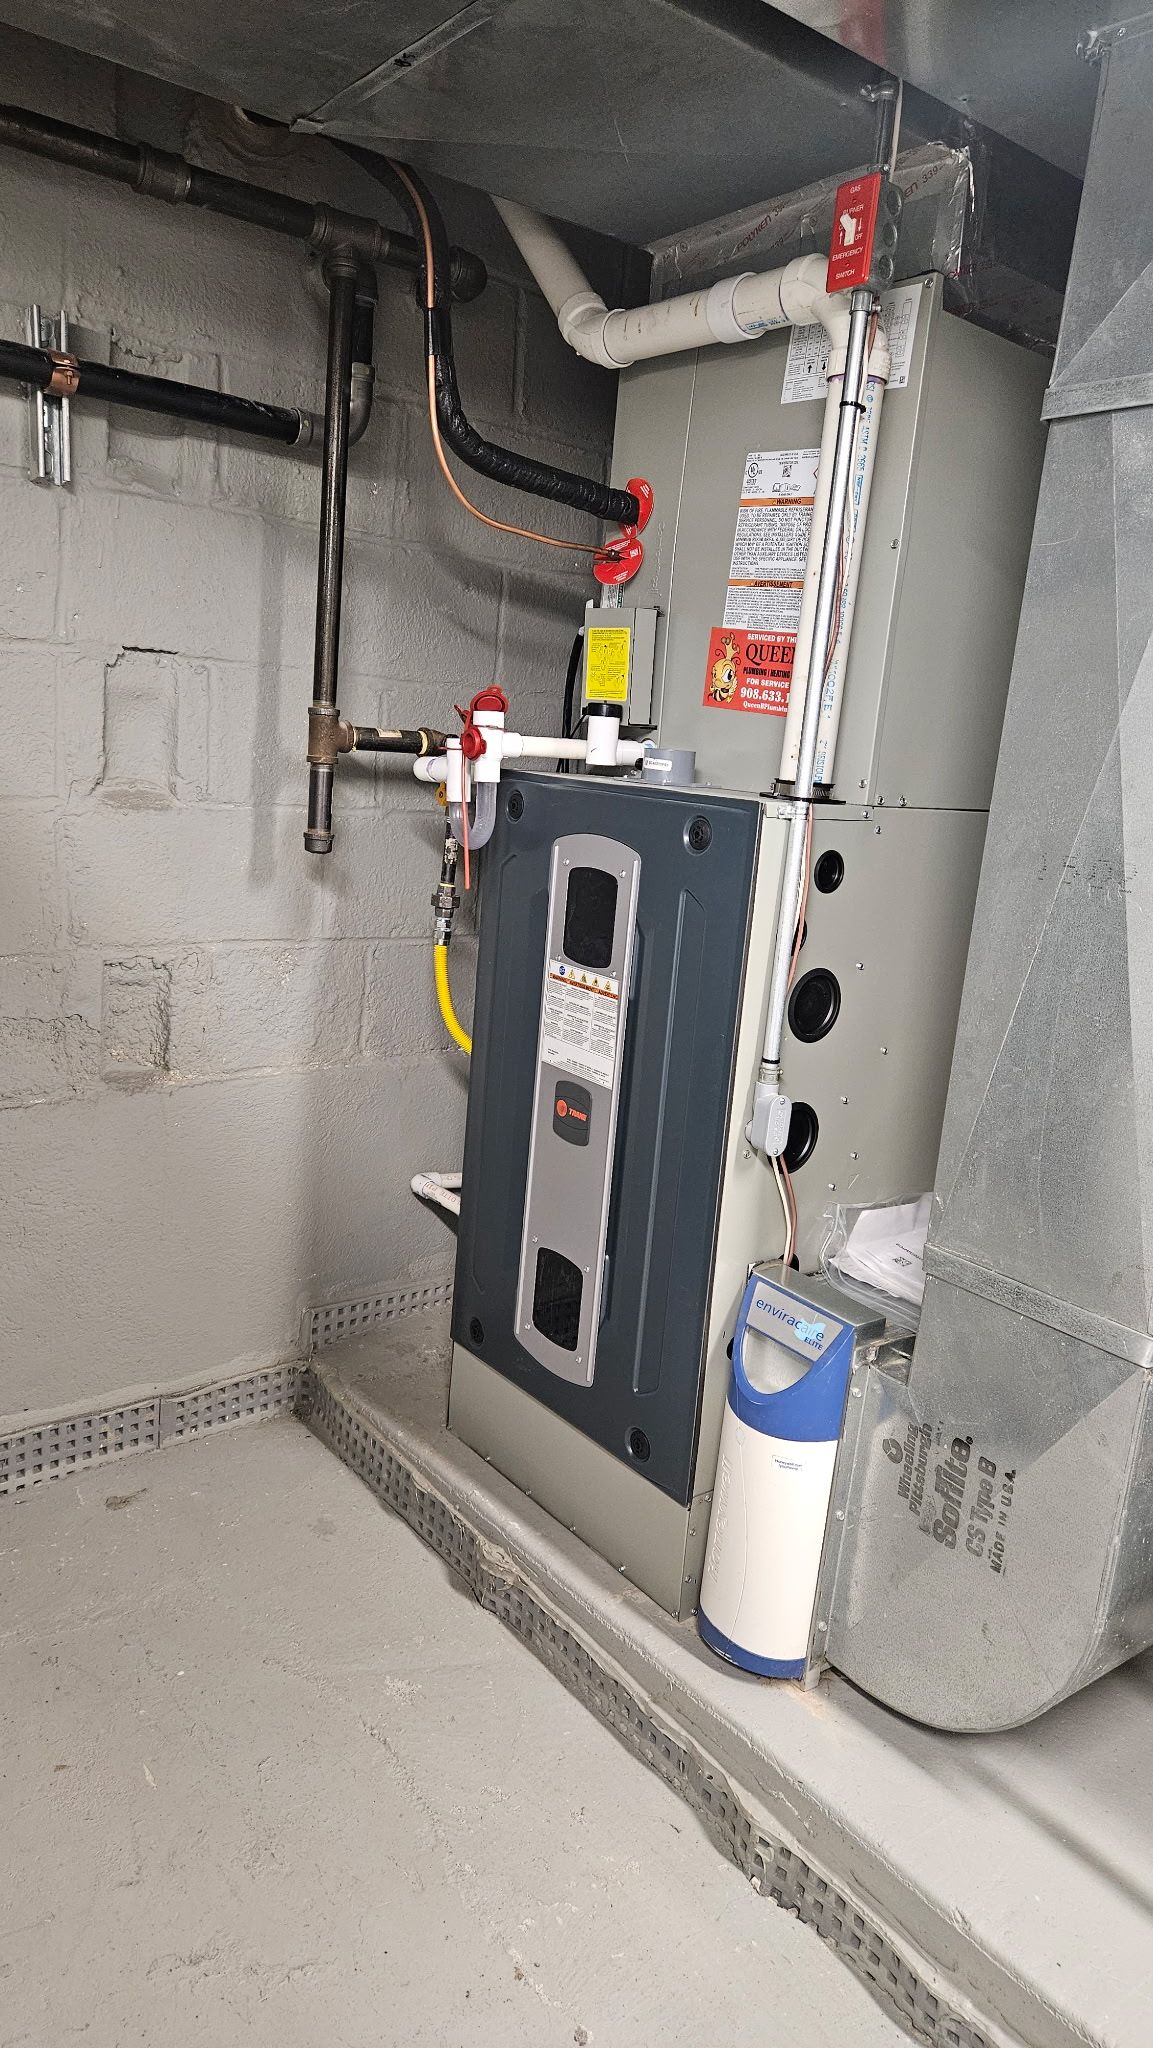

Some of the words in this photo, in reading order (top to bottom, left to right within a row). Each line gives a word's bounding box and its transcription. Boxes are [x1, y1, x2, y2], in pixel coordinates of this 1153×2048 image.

[850, 184, 862, 194] GAS
[737, 214, 772, 252] POLYKEN
[854, 232, 864, 242] OFF
[832, 246, 864, 262] EMERGENCY
[835, 268, 856, 280] SWITCH
[754, 580, 793, 588] AVERTISSEMENT
[748, 633, 776, 642] SERVICED
[777, 635, 786, 643] BY
[743, 666, 768, 677] PLUMBING
[770, 669, 791, 678] HEATING
[746, 678, 760, 686] FOR
[761, 679, 790, 689] SERVICE
[568, 1107, 588, 1122] TRANE
[756, 1299, 824, 1342] enviracaire
[804, 1336, 823, 1351] ELITE
[897, 1422, 919, 1500] Wheeling
[977, 1456, 997, 1479] B
[909, 1423, 933, 1517] Pittsburgh
[969, 1478, 996, 1524] Type
[966, 1523, 986, 1558] CS
[990, 1531, 1006, 1574] MADE
[998, 1510, 1008, 1527] IN
